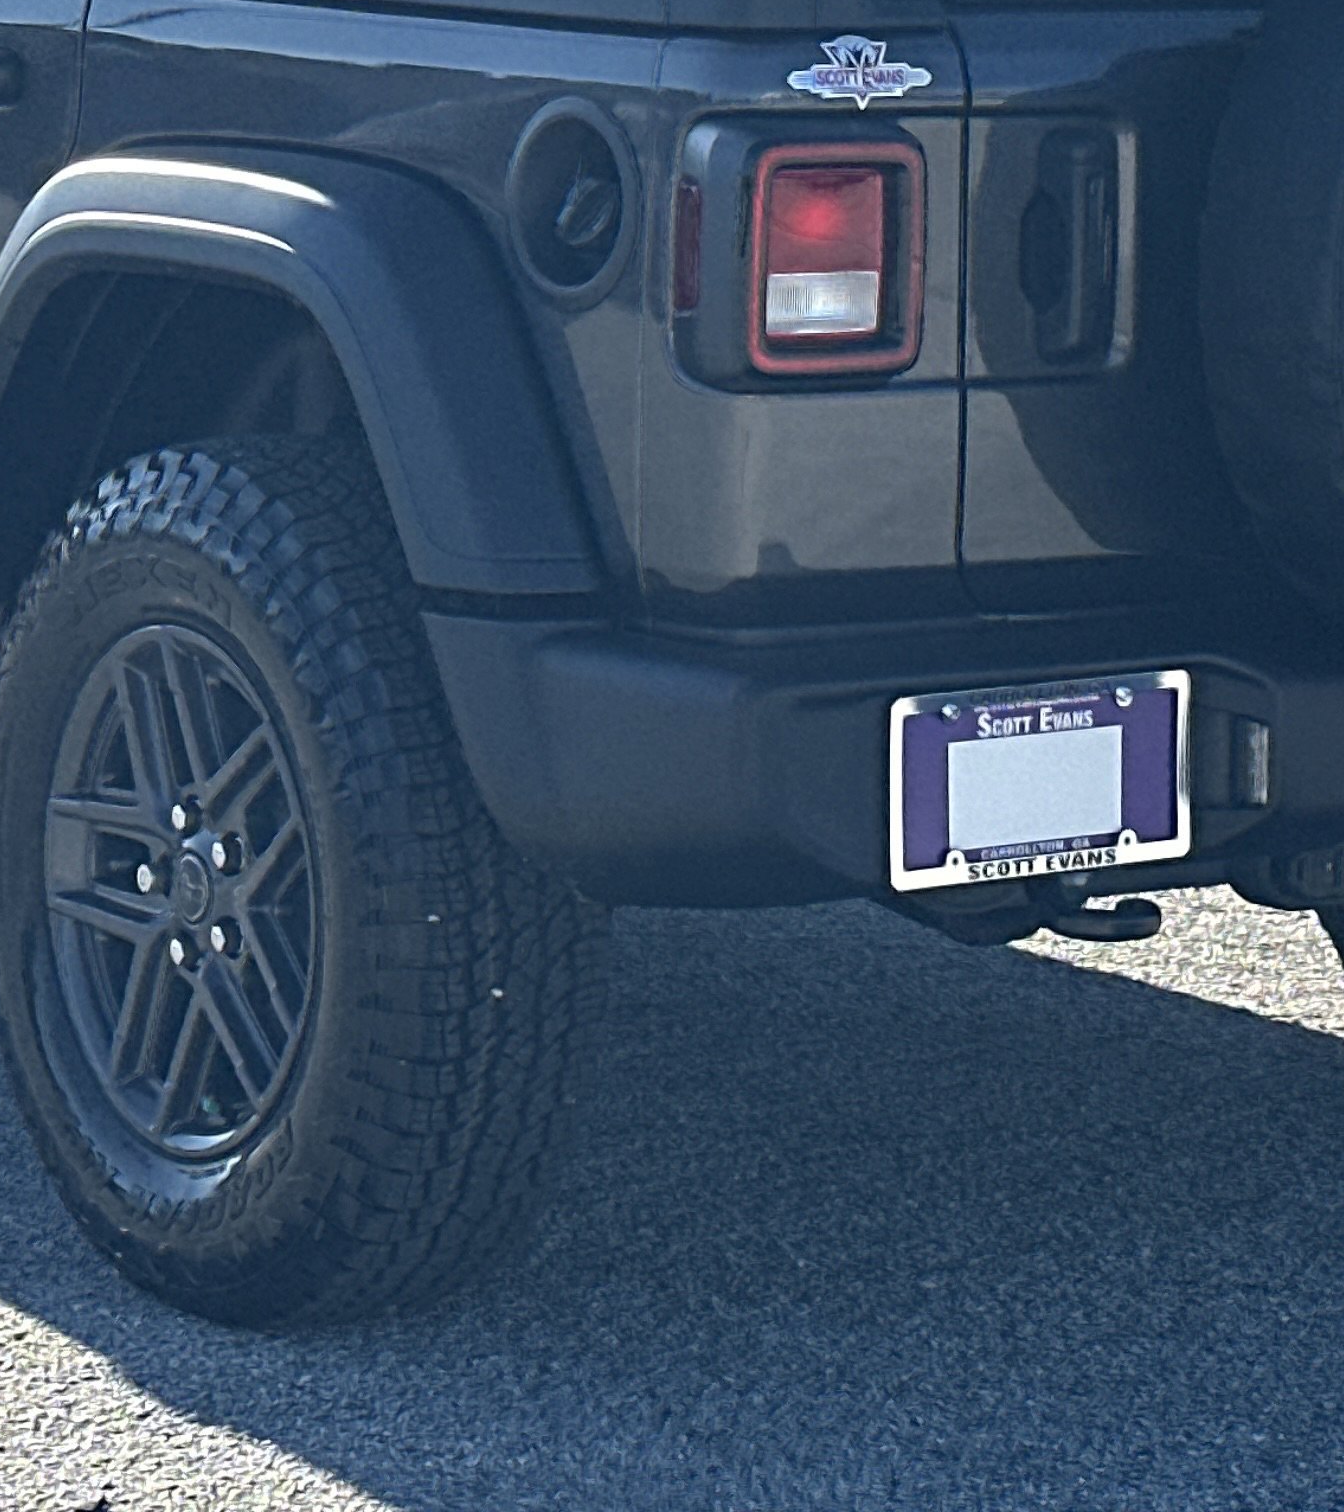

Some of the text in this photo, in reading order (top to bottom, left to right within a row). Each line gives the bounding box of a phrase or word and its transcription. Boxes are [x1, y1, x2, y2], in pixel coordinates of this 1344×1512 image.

[976, 706, 1093, 738] SCOTT EVANS
[968, 849, 1116, 880] SCOTT EVANS
